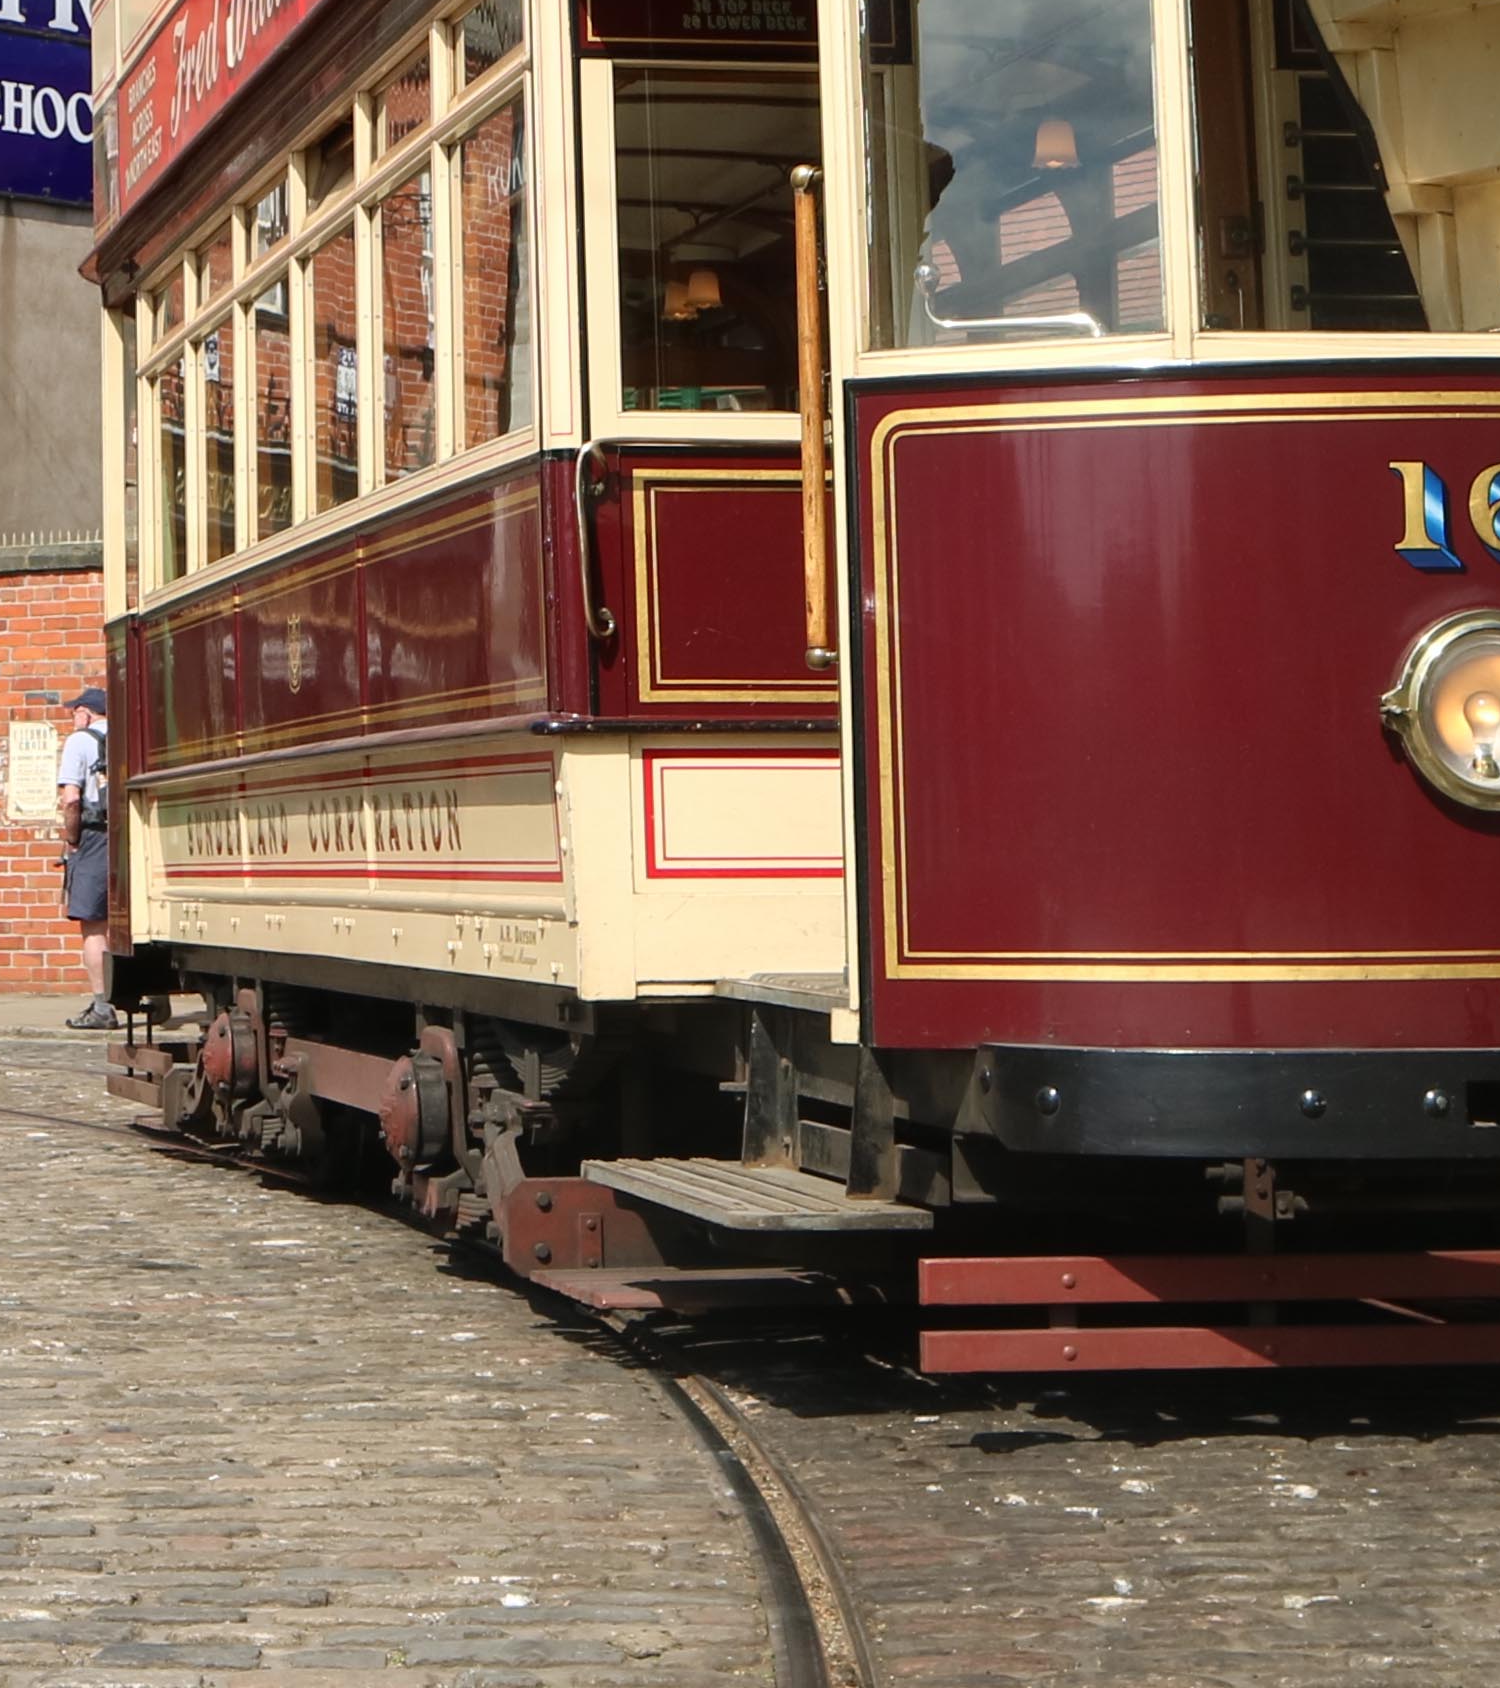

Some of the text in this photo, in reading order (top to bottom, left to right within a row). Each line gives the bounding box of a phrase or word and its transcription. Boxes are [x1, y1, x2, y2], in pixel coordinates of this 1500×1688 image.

[719, 0, 748, 14] TOP
[752, 1, 792, 15] DECK
[707, 15, 762, 30] LOWER
[766, 16, 807, 30] DECK
[132, 100, 154, 150] ACROSS
